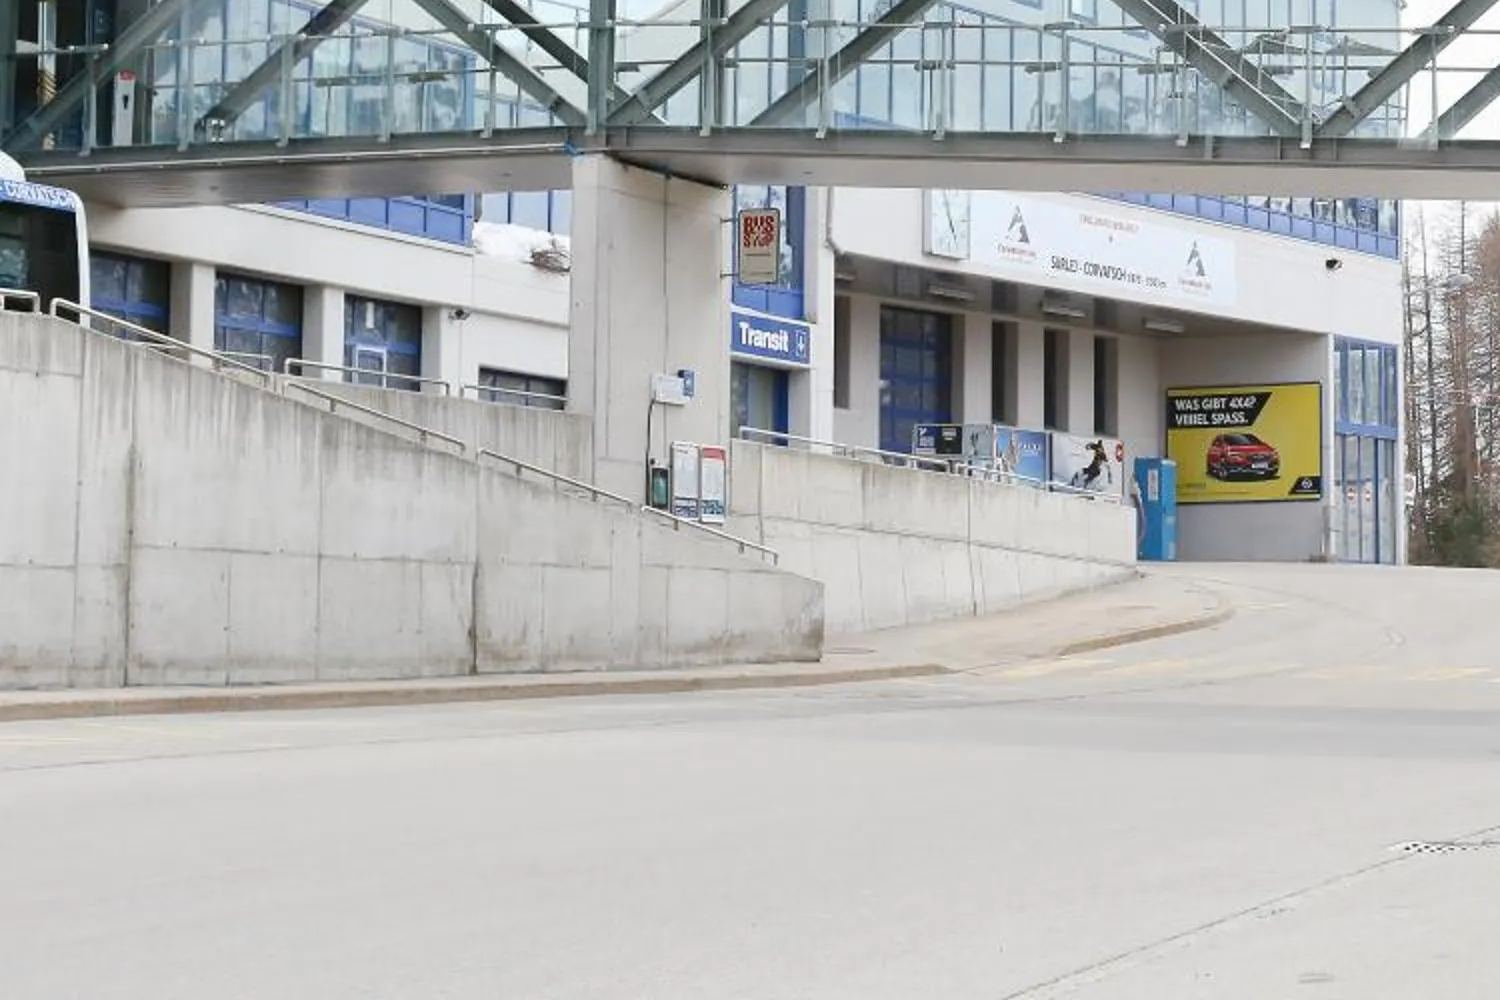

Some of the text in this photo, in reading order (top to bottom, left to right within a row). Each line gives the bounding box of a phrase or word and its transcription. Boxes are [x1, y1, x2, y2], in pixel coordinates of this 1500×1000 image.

[744, 216, 774, 233] BUS
[739, 321, 789, 353] Transit
[1175, 398, 1200, 411] WAS
[1201, 397, 1228, 410] GIBT
